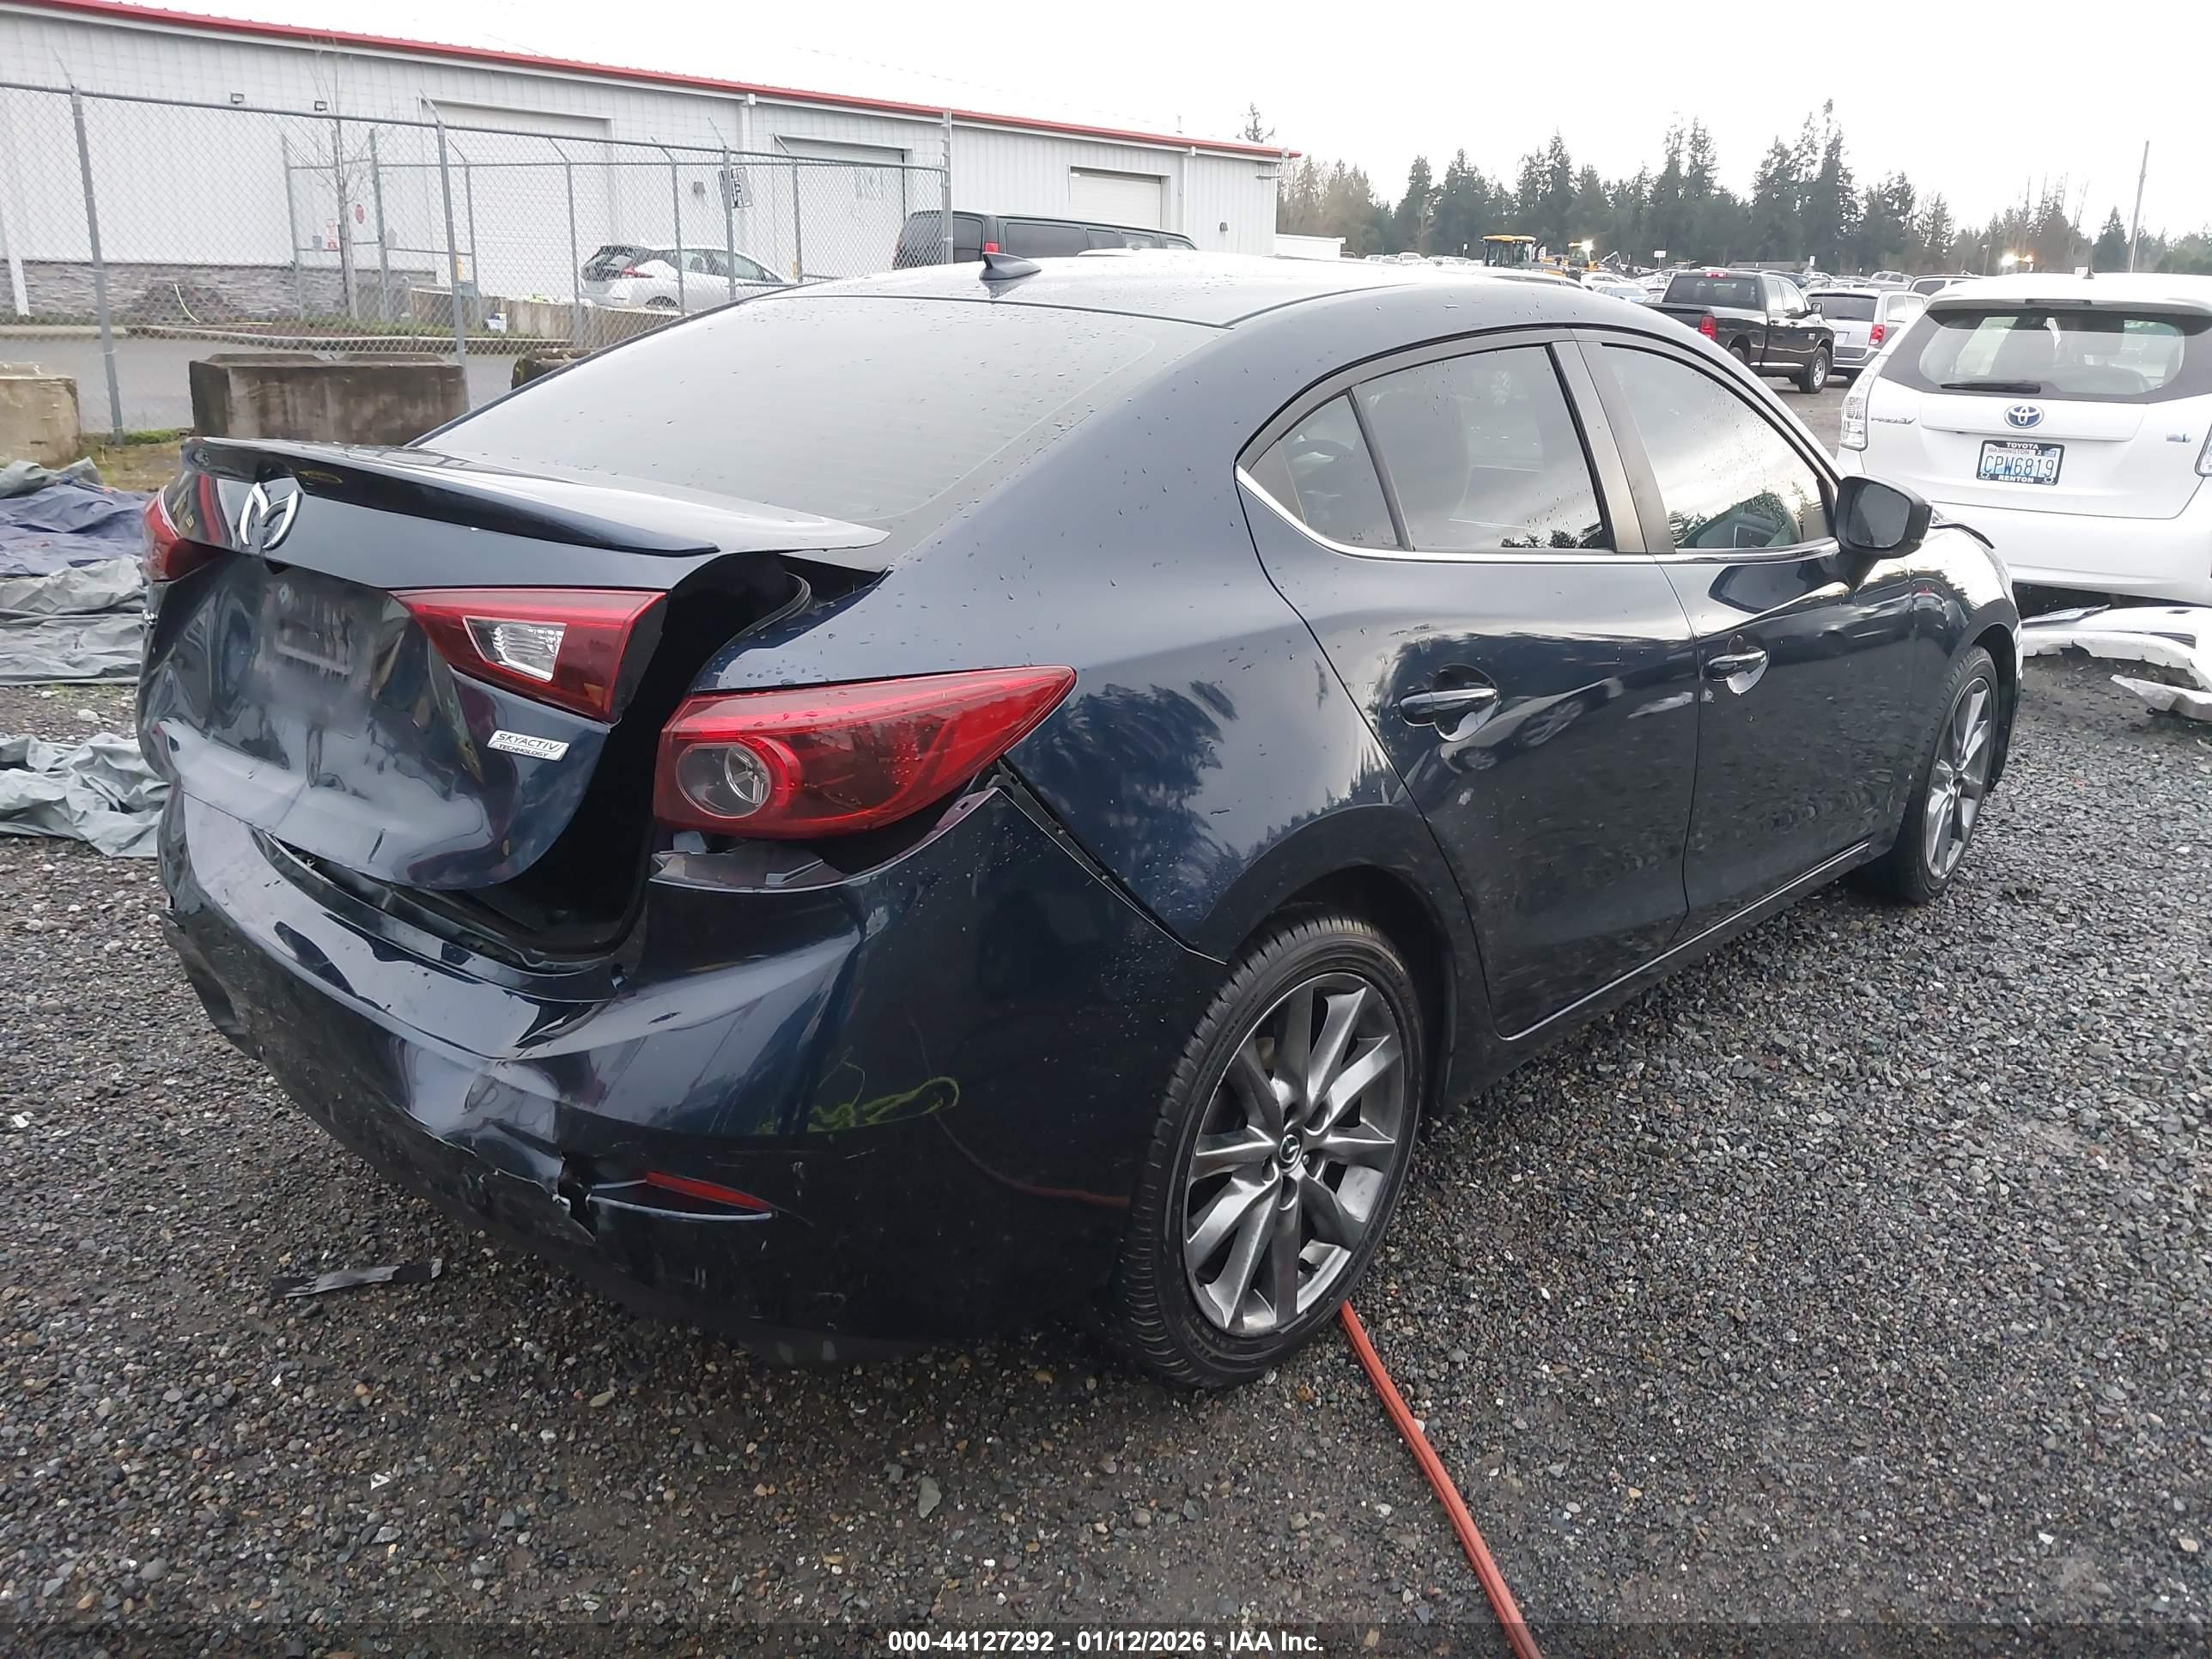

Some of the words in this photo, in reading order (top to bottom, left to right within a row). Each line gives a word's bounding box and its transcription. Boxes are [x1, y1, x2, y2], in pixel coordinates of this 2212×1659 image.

[1987, 447, 2030, 455] WASHINGTON
[1984, 455, 2055, 477] CPW6819
[1997, 475, 2034, 483] RENTON
[495, 733, 560, 750] SKYACTIV
[498, 744, 550, 757] TECHNOLOGY
